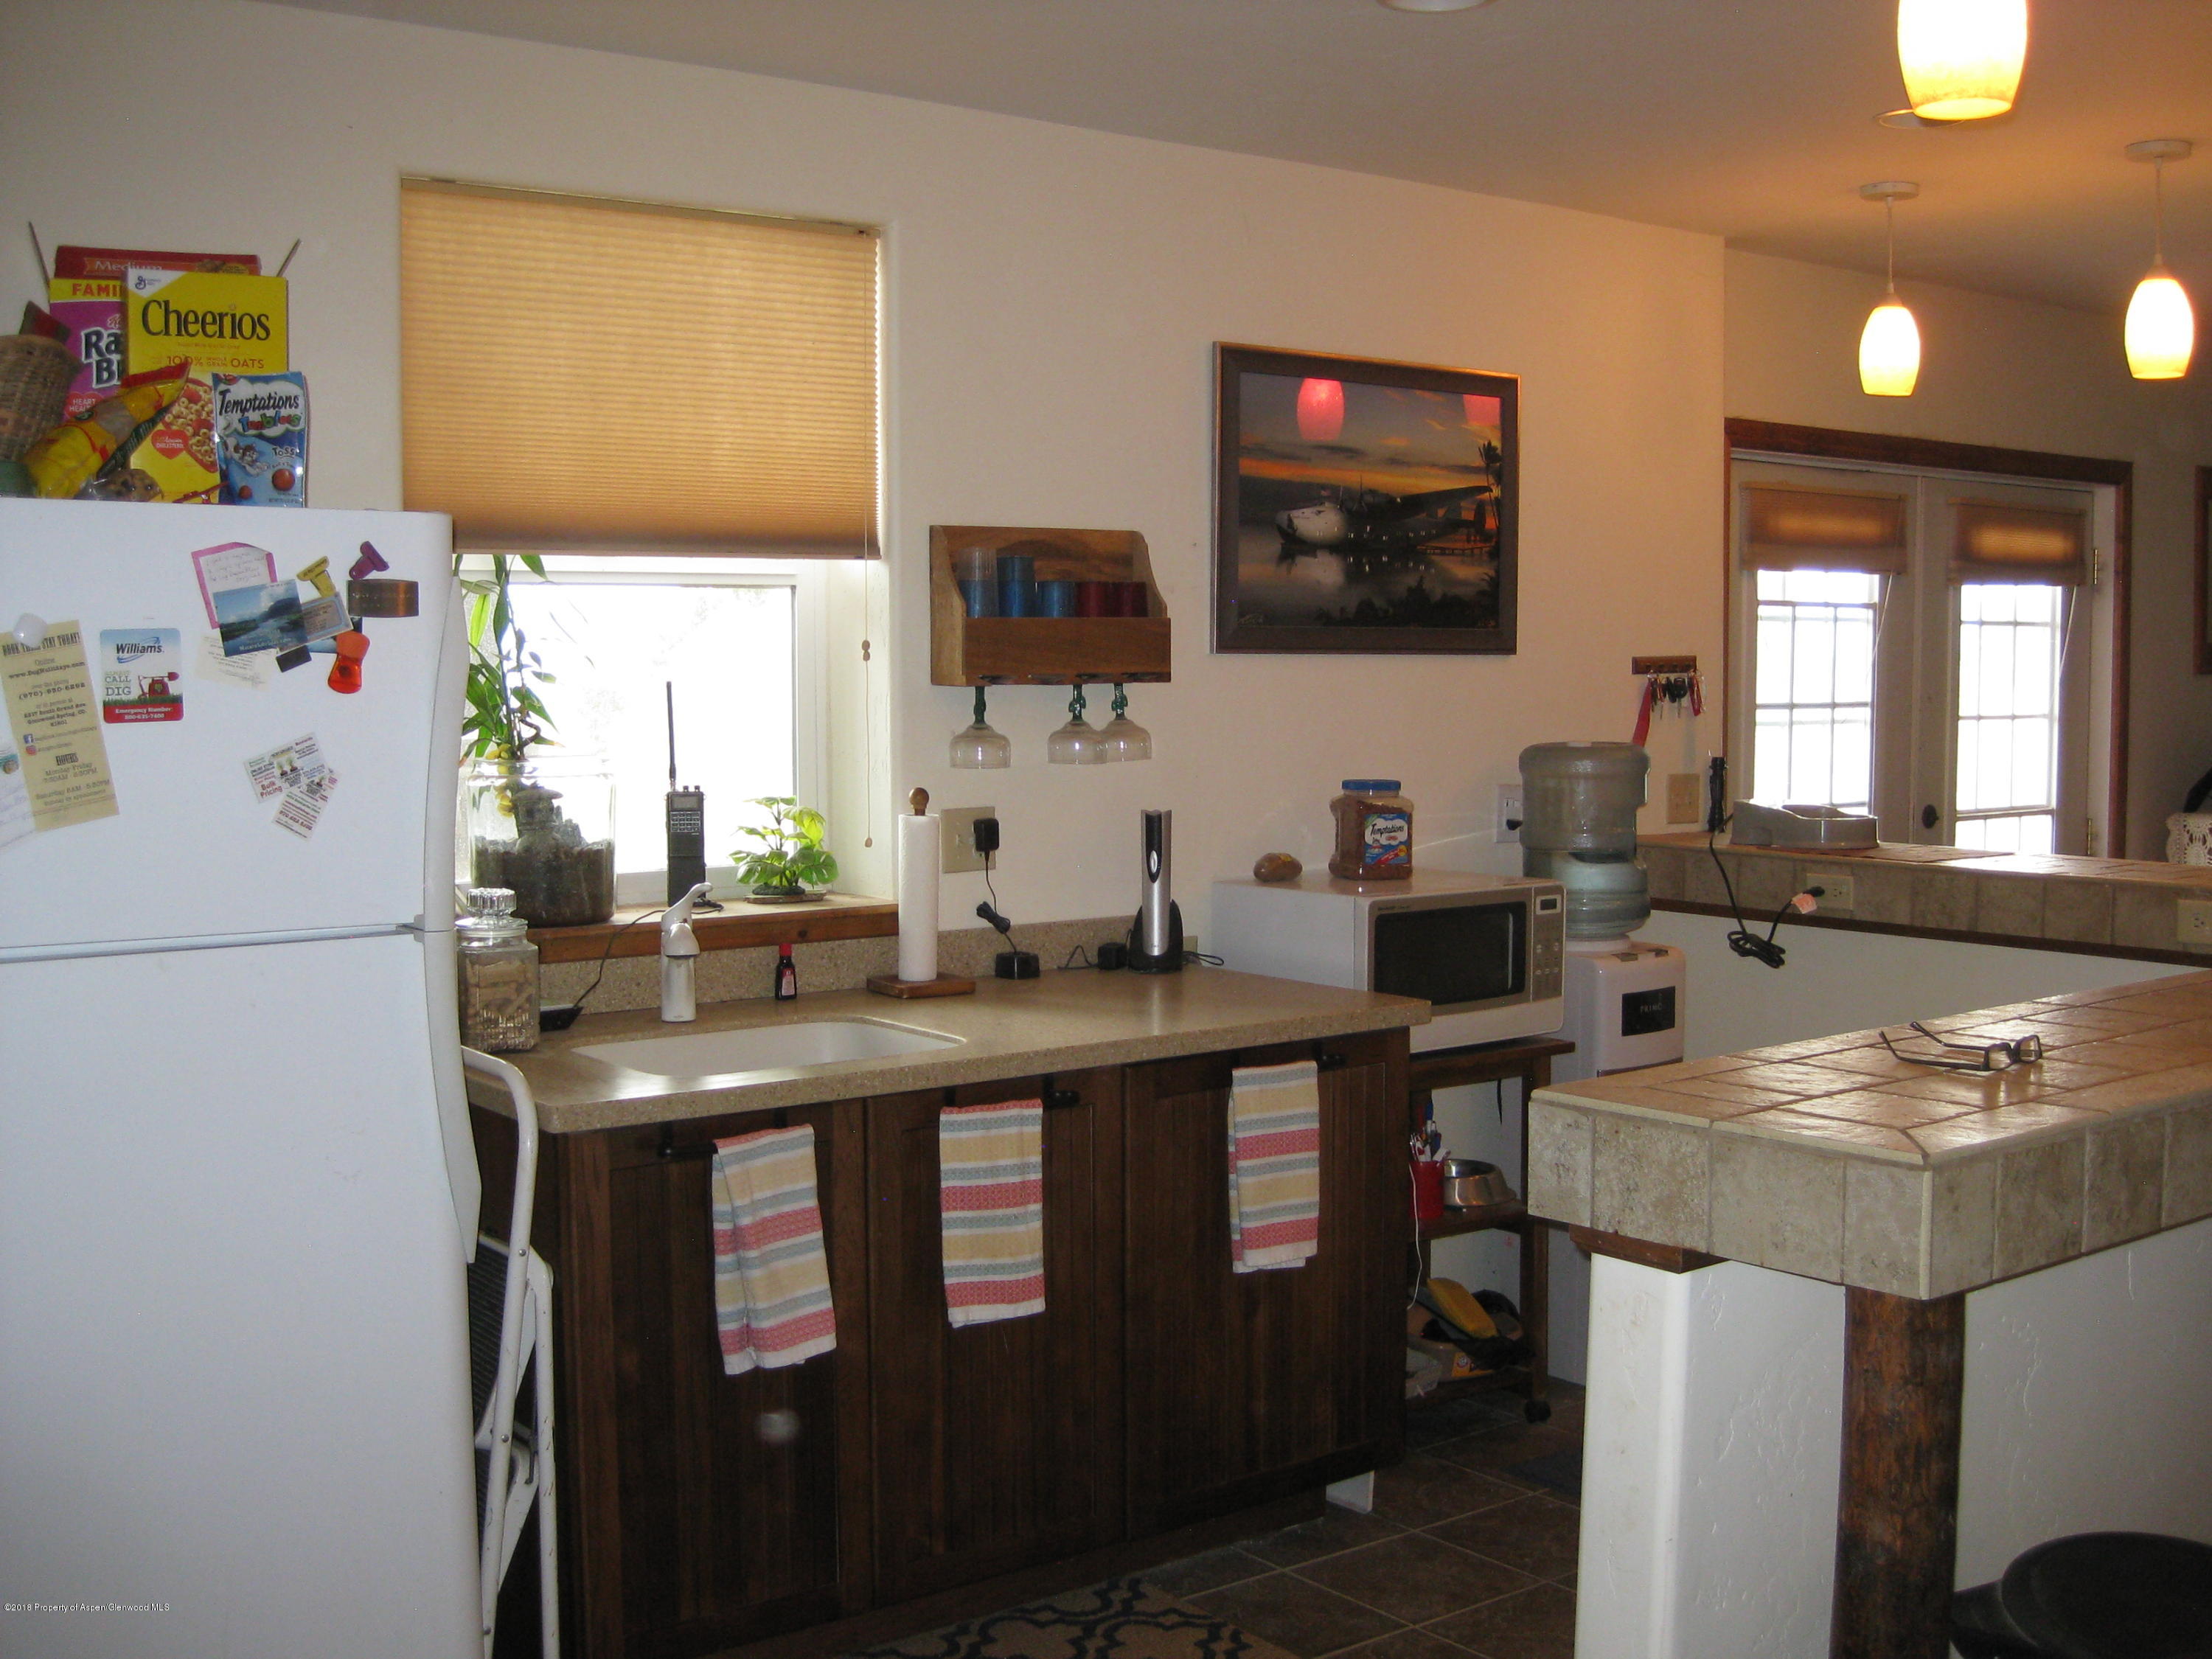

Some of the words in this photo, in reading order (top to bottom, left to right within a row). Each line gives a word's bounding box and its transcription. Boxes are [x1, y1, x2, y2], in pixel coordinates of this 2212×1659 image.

[142, 299, 271, 341] Cheerios
[231, 358, 265, 369] OATS
[218, 389, 301, 417] Temptations
[104, 675, 132, 684] CALL
[105, 686, 132, 697] DIG
[260, 780, 276, 791] Bulk
[260, 785, 283, 799] Pricing
[1370, 823, 1405, 838] Temptations
